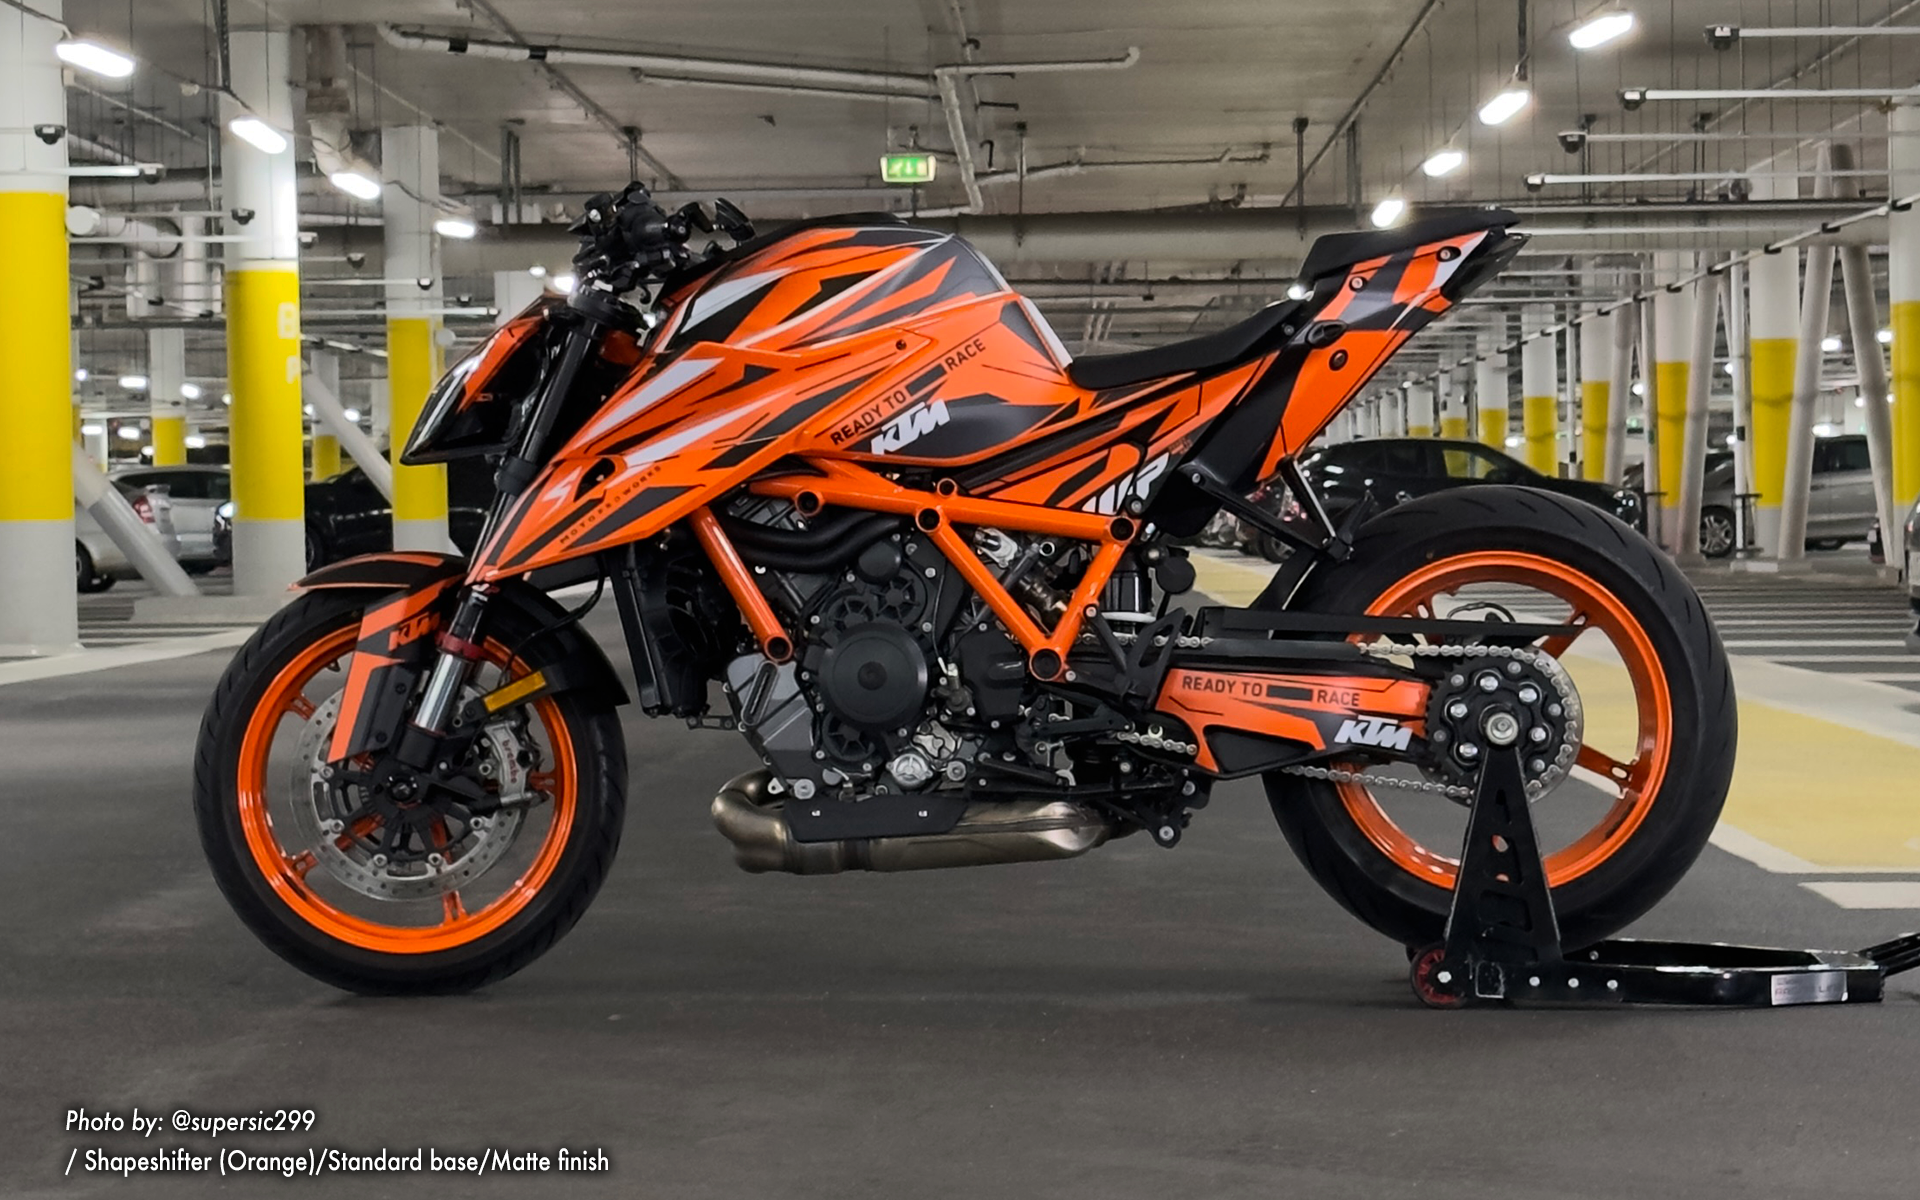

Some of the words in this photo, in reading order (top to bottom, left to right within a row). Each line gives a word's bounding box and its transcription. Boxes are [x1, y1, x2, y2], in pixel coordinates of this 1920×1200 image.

[830, 404, 883, 446] READY
[882, 390, 907, 411] TO
[944, 338, 987, 371] RACE
[870, 398, 951, 456] KTM
[388, 611, 441, 652] KTM
[1181, 675, 1237, 694] READY
[1241, 681, 1263, 697] TO
[1316, 690, 1360, 707] RACE
[1333, 715, 1413, 751] KTM
